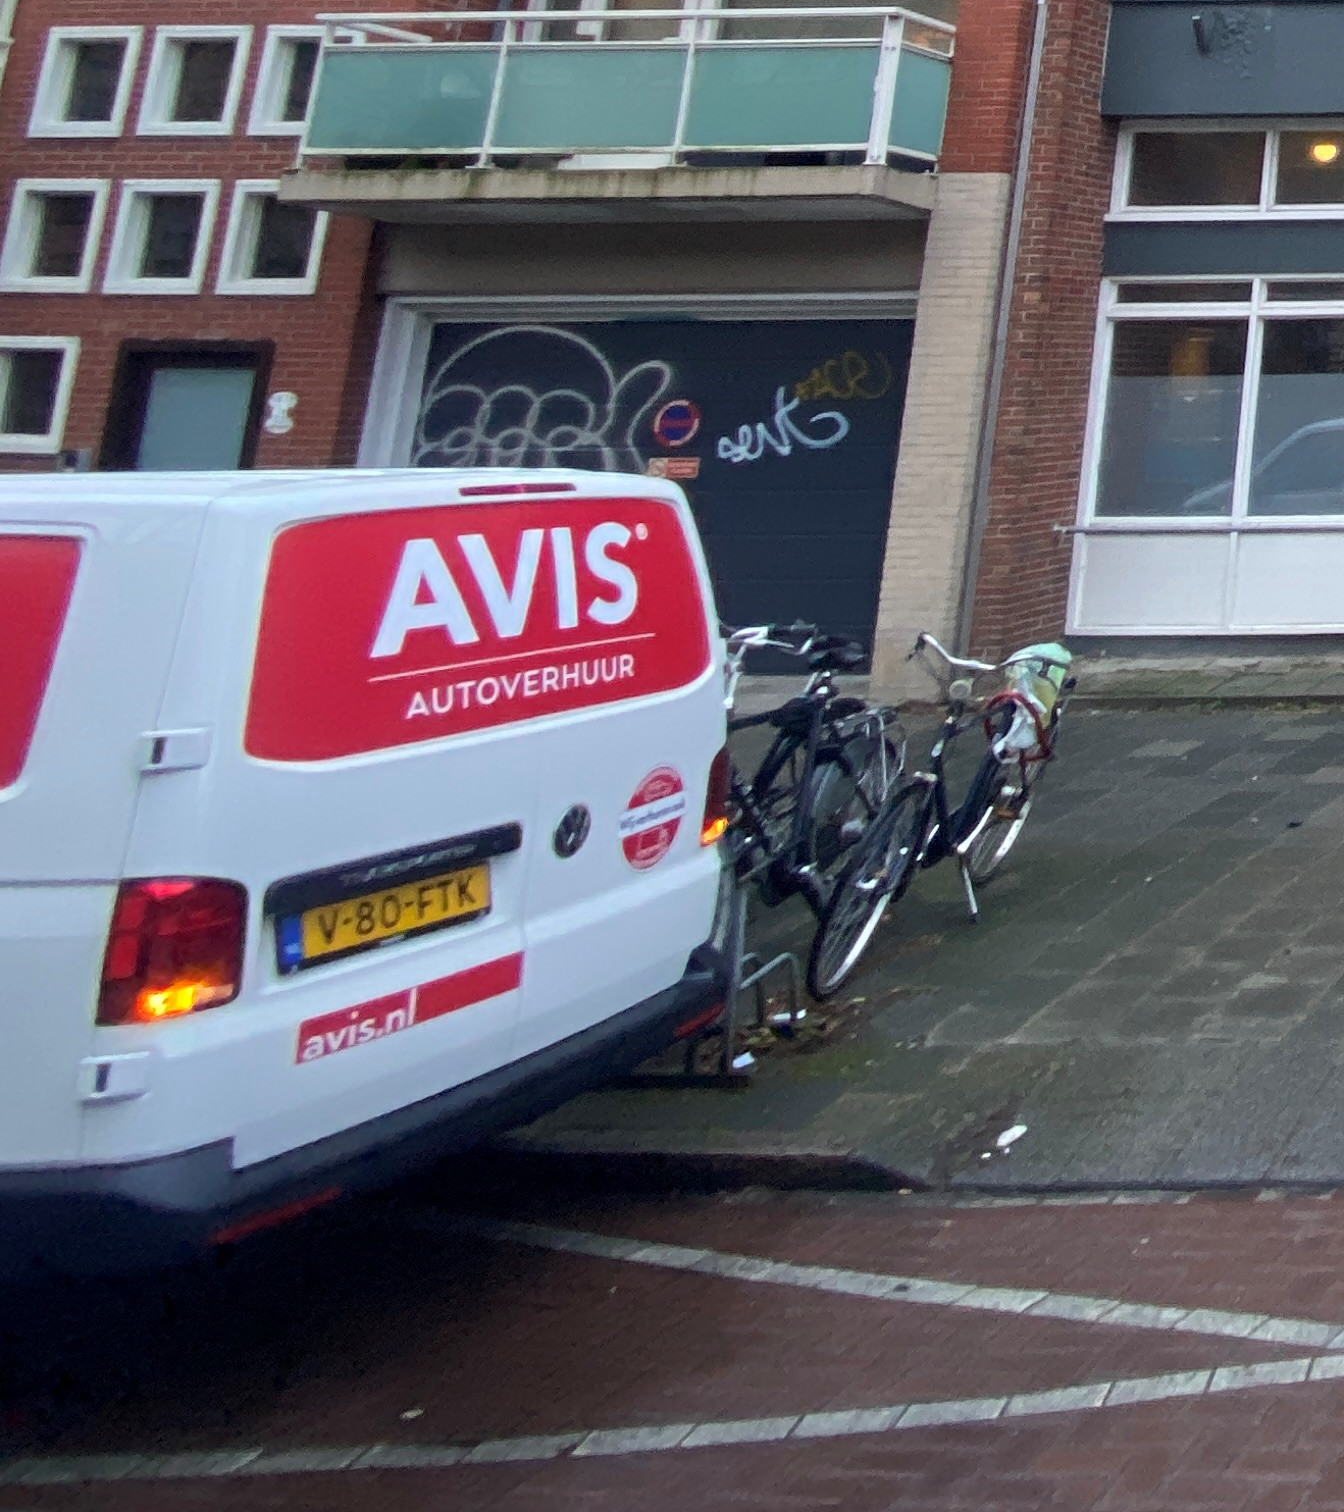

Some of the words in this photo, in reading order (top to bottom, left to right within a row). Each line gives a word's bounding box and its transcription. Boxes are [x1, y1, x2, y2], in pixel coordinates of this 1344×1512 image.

[405, 654, 635, 720] AUTOVERHUUR
[317, 873, 477, 945] V-80-FTK
[301, 987, 418, 1061] avis.nl
